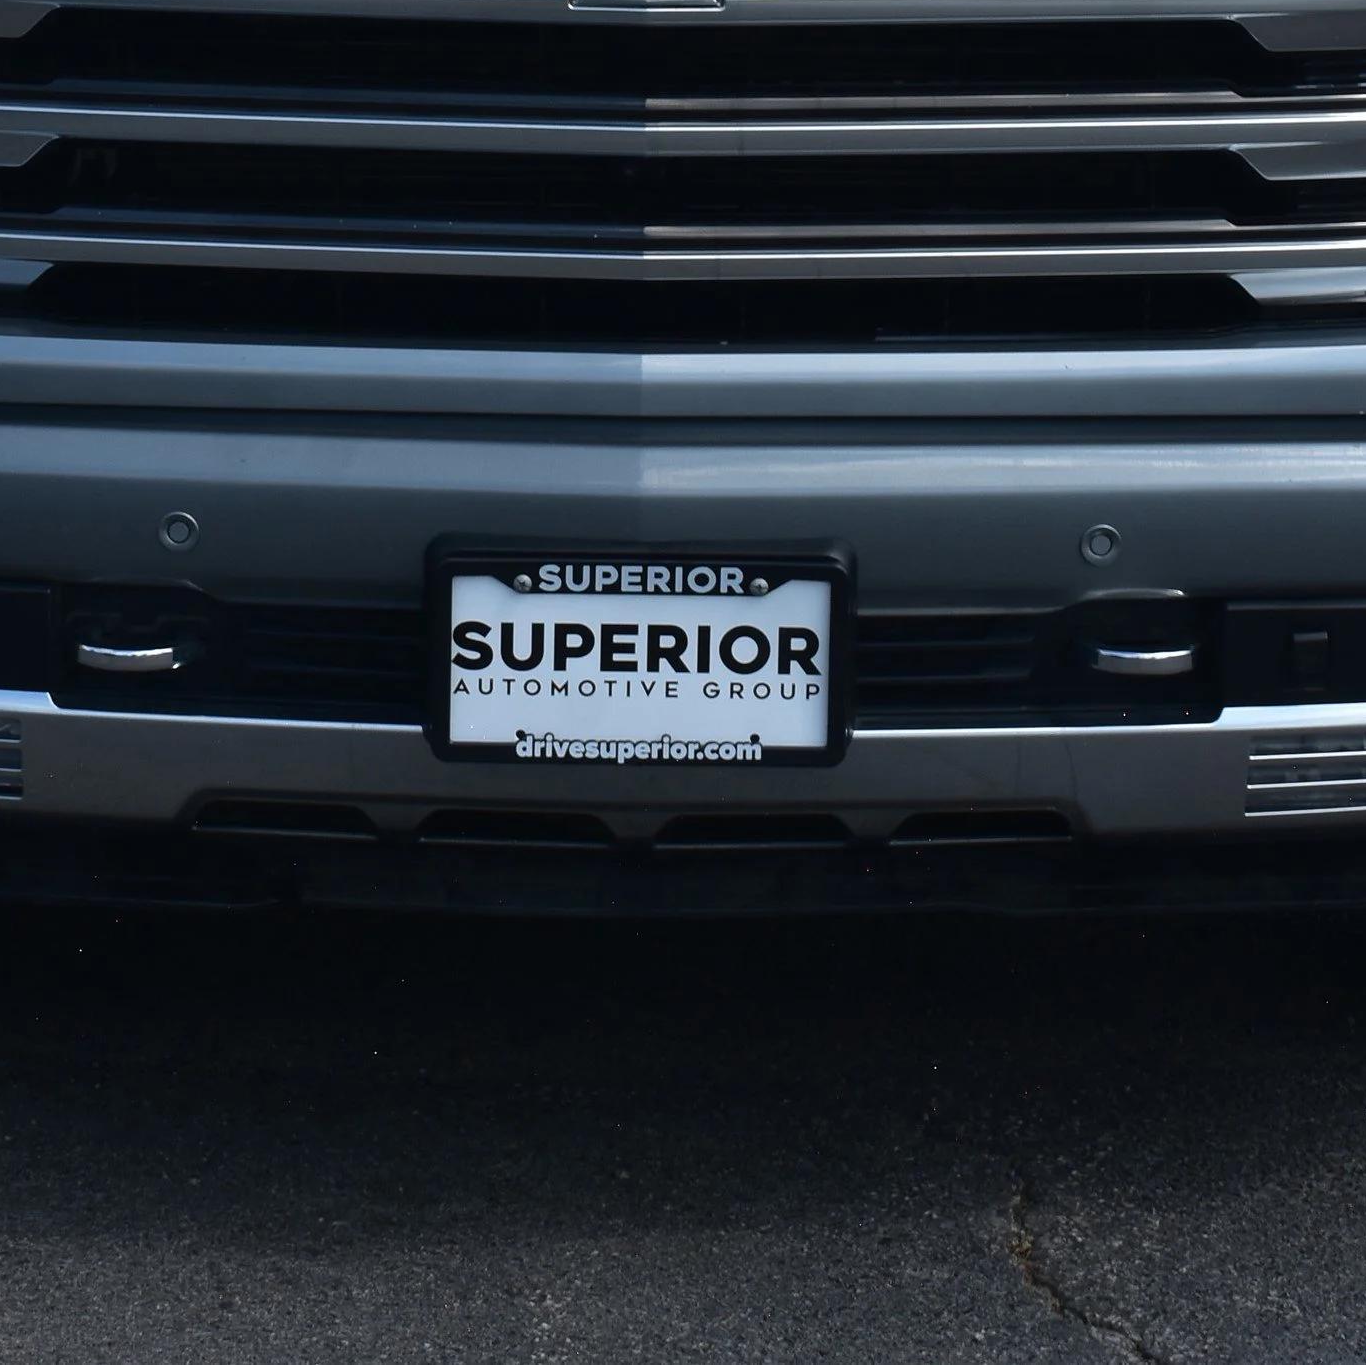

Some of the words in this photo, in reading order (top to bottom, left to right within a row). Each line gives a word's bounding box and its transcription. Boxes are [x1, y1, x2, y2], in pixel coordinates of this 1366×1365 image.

[538, 563, 745, 594] SUPERIOR
[451, 620, 822, 676] SUPERIOR
[453, 678, 680, 699] AUTOMOTIVE
[702, 681, 821, 701] GROUP
[515, 733, 763, 765] drivesuperior.com
